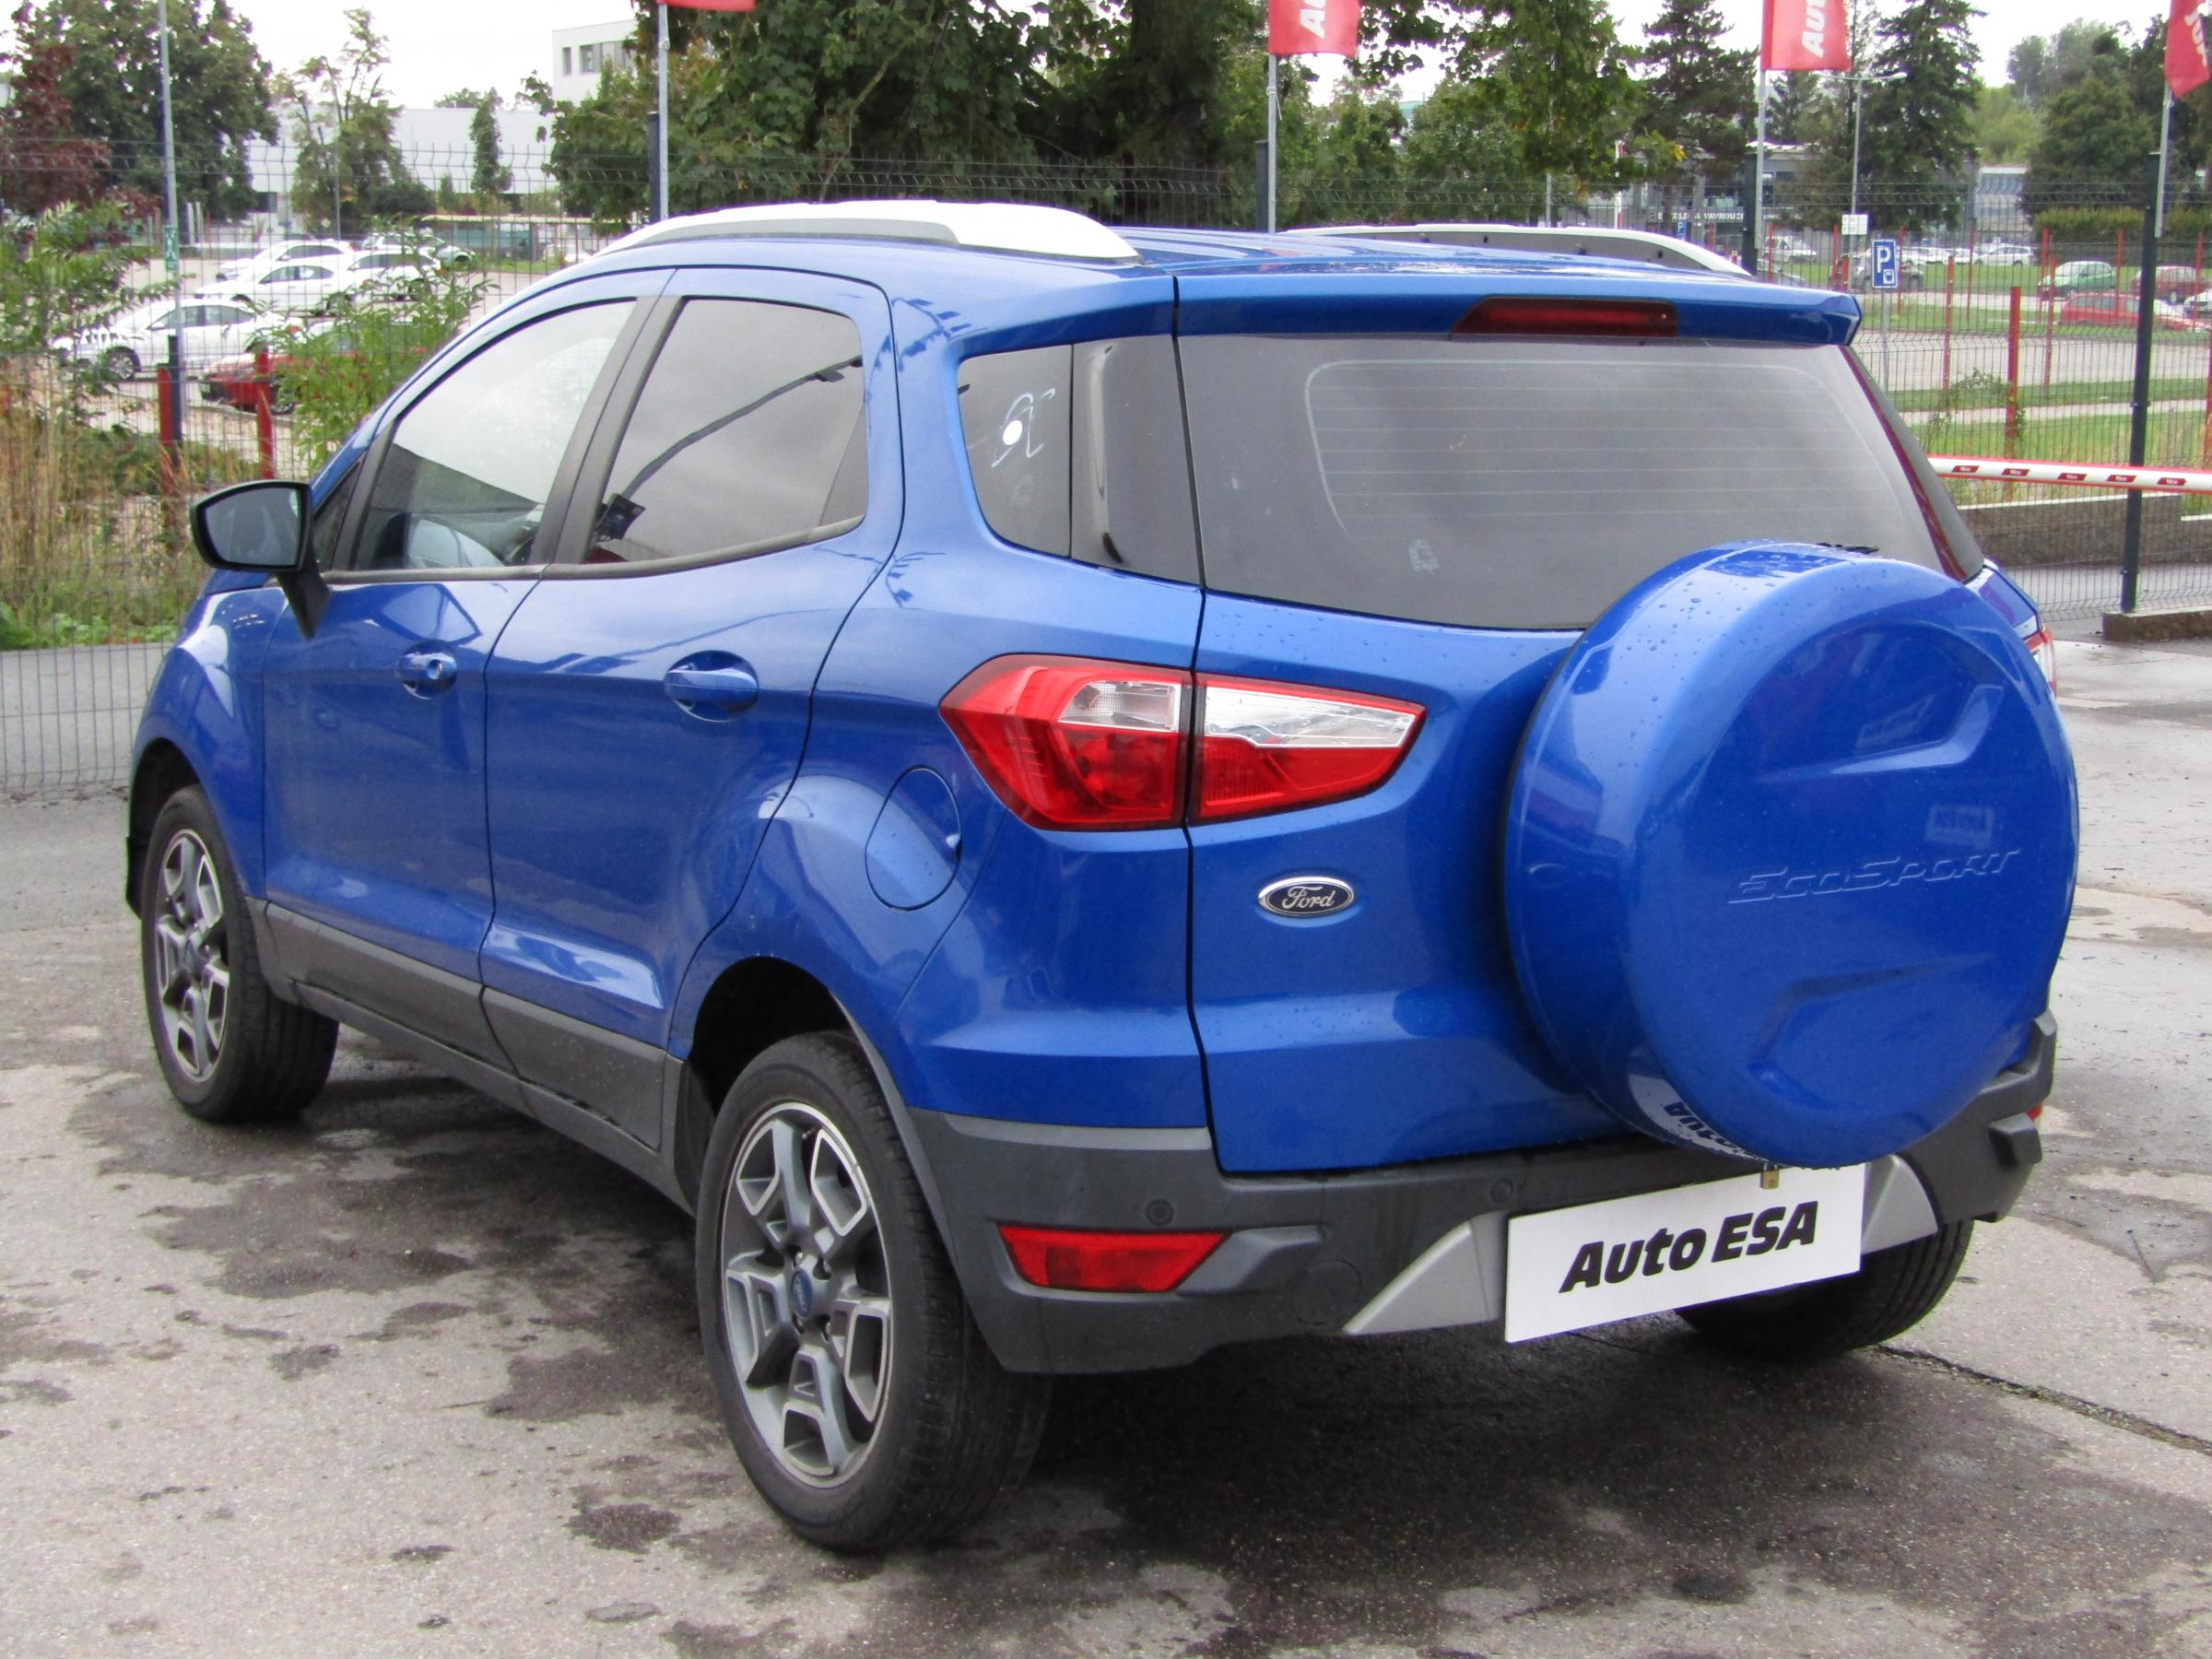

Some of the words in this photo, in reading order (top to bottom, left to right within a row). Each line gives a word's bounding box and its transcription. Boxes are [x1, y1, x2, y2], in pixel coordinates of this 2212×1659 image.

[1877, 245, 1891, 274] P
[1281, 886, 1336, 910] Ford
[1558, 1228, 1707, 1294] Auto
[1711, 1200, 1819, 1263] ESA
